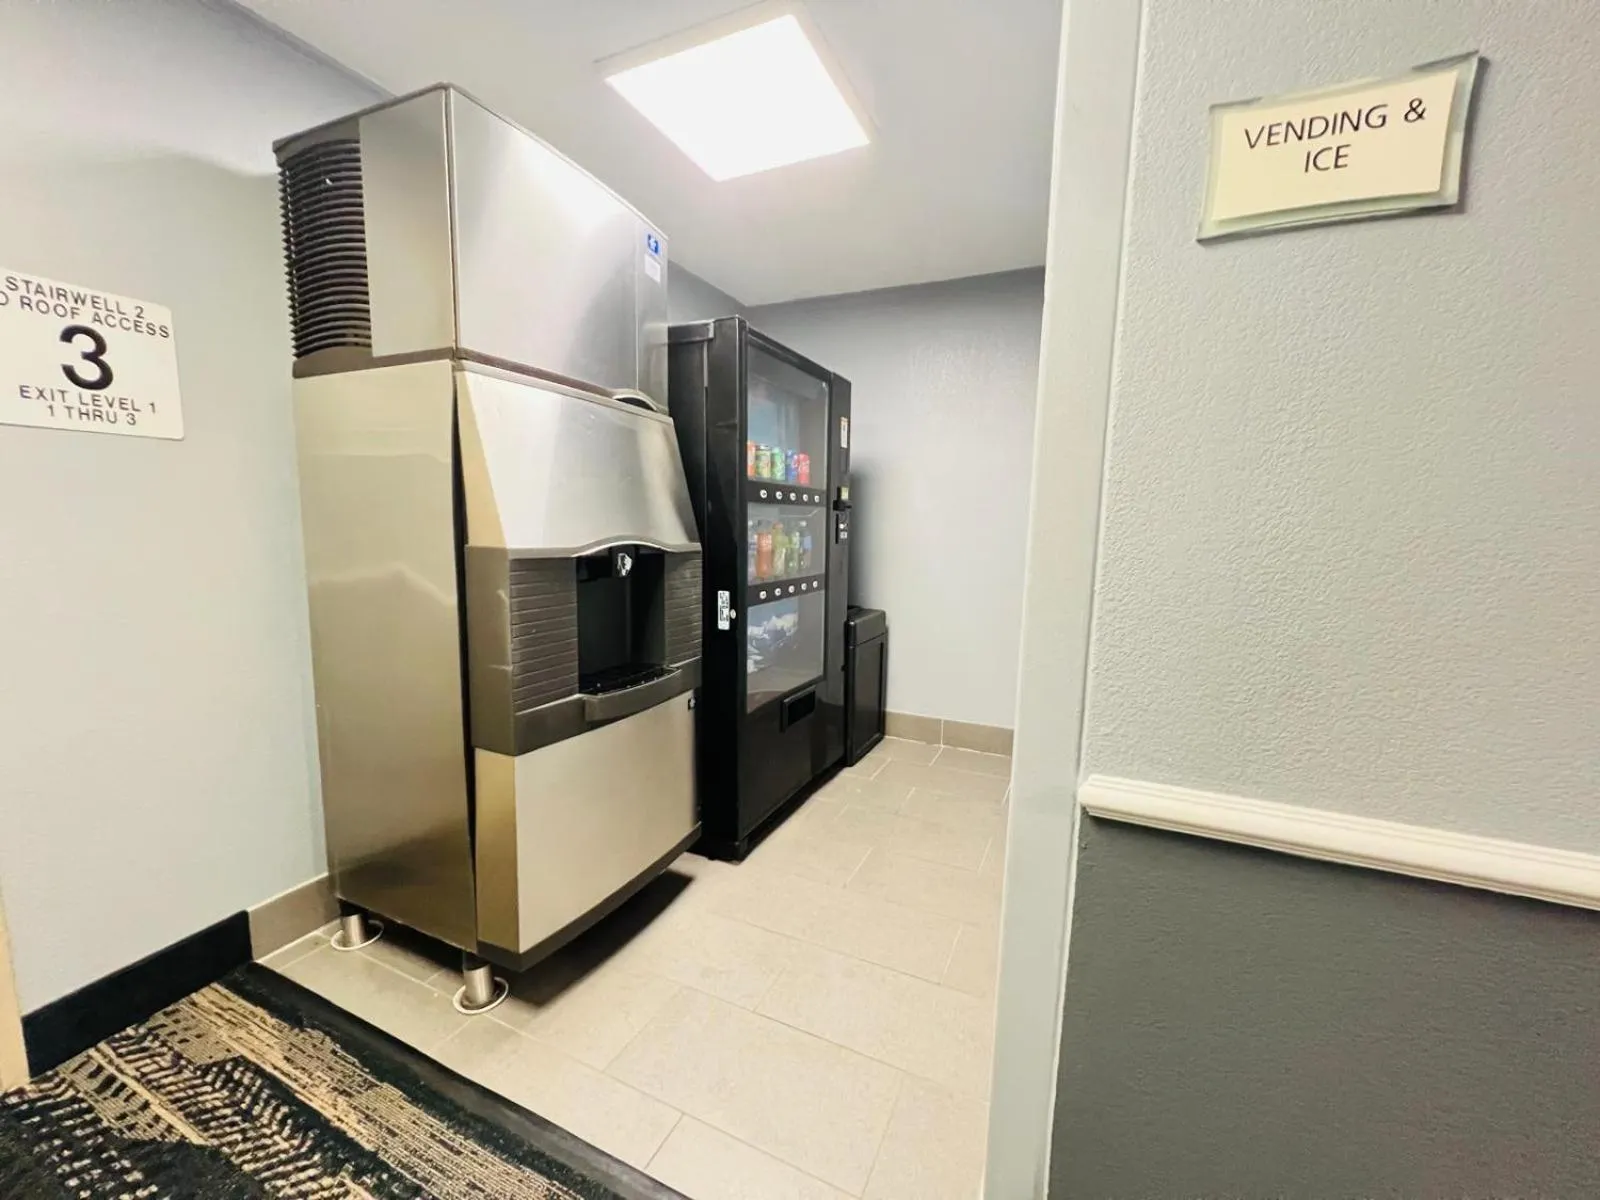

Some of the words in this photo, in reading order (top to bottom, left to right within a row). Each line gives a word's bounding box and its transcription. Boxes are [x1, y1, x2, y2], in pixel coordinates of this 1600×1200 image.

[1244, 104, 1388, 149] VENDING
[1403, 97, 1426, 123] &
[1304, 144, 1351, 173] ICE
[5, 276, 126, 315] STAIRWELL
[135, 305, 144, 319] 2
[20, 295, 80, 319] ROOF
[92, 311, 170, 338] ACCESS
[59, 324, 113, 390] 3
[19, 385, 68, 403] EXIT
[78, 391, 141, 412] LEVEL
[149, 401, 156, 413] 1
[48, 404, 55, 417] 1
[65, 406, 117, 424] THRU
[126, 412, 136, 426] 3
